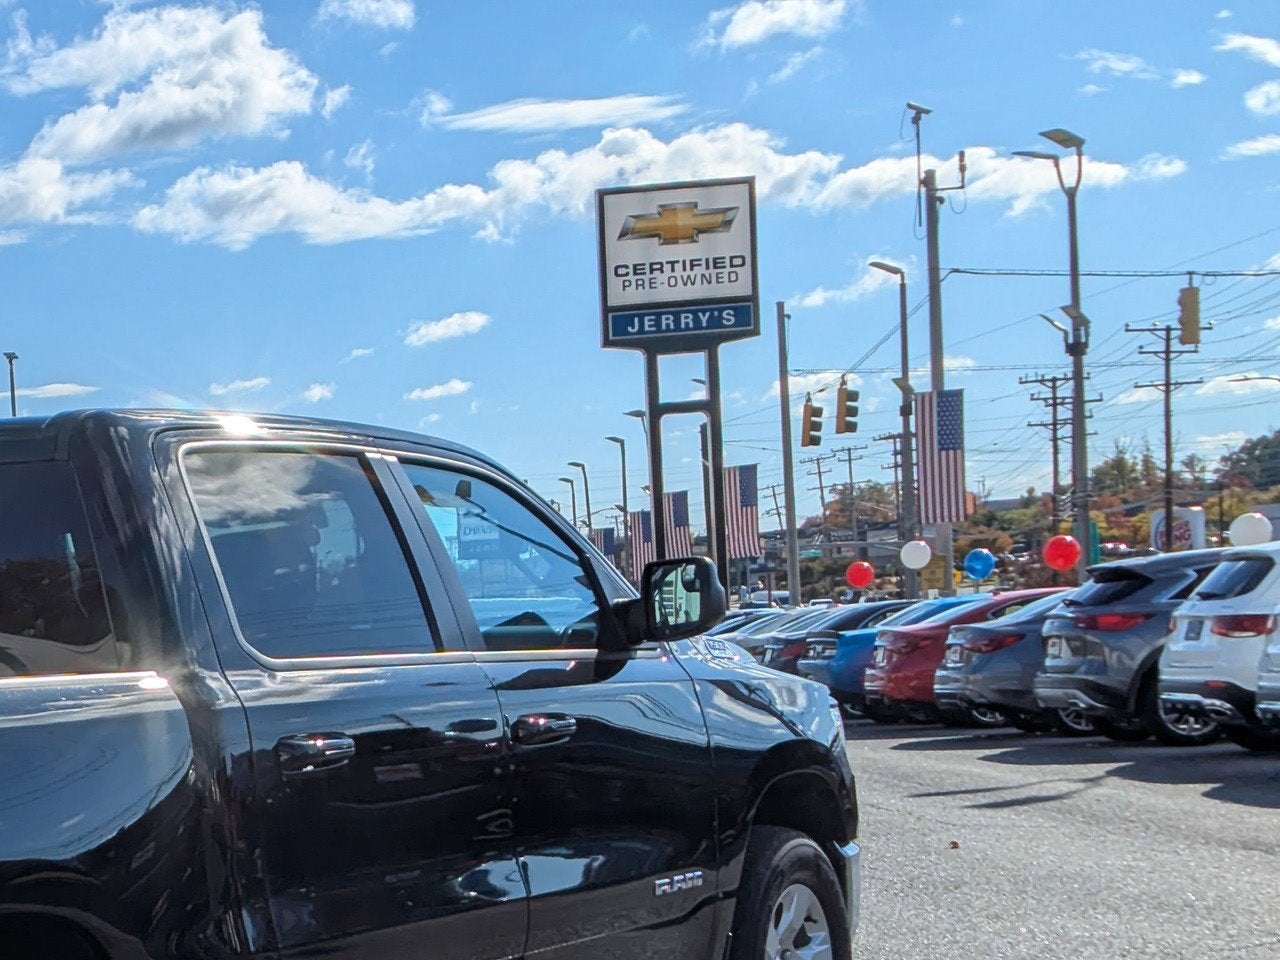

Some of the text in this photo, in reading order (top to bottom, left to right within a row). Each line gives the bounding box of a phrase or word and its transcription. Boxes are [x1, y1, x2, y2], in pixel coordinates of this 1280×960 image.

[614, 254, 746, 278] CERTIFIED
[622, 271, 739, 292] PRE-OWNED
[627, 309, 736, 333] JERRY'S
[654, 870, 703, 896] RAM
